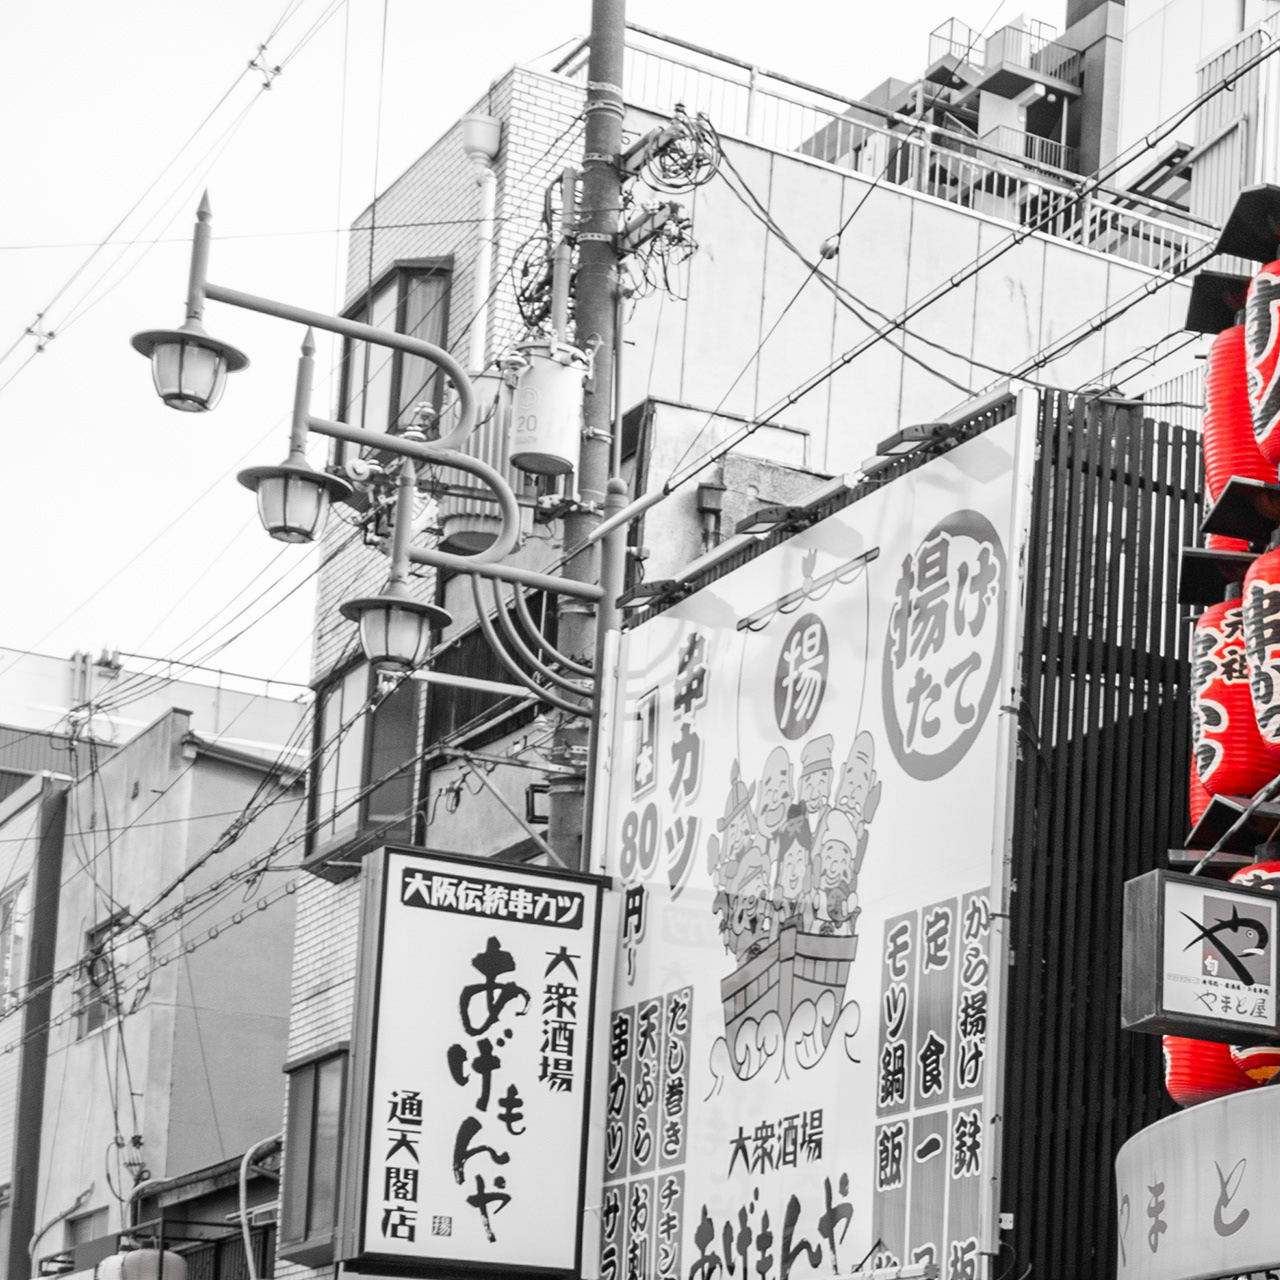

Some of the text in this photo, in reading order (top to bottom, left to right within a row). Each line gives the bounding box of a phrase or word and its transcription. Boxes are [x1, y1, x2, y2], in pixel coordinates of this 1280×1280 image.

[894, 535, 997, 668] 揚げ
[664, 631, 706, 892] 串カツ
[905, 650, 981, 750] たて
[403, 872, 584, 923] 大阪伝統串カツ
[1204, 955, 1219, 976] 旬
[539, 946, 581, 1093] 大衆酒場
[880, 922, 910, 1106] モツ鍋
[919, 907, 951, 1096] 定食
[958, 899, 989, 1087] から揚げ
[1194, 989, 1268, 1019] やまと屋
[447, 936, 530, 1243] あげもんや
[607, 1014, 629, 1171] 串カツ
[633, 1000, 658, 1165] 天ぷら
[663, 989, 691, 1158] だし巻き
[728, 1109, 823, 1179] 大衆酒場
[382, 1089, 423, 1243] 通天閣店
